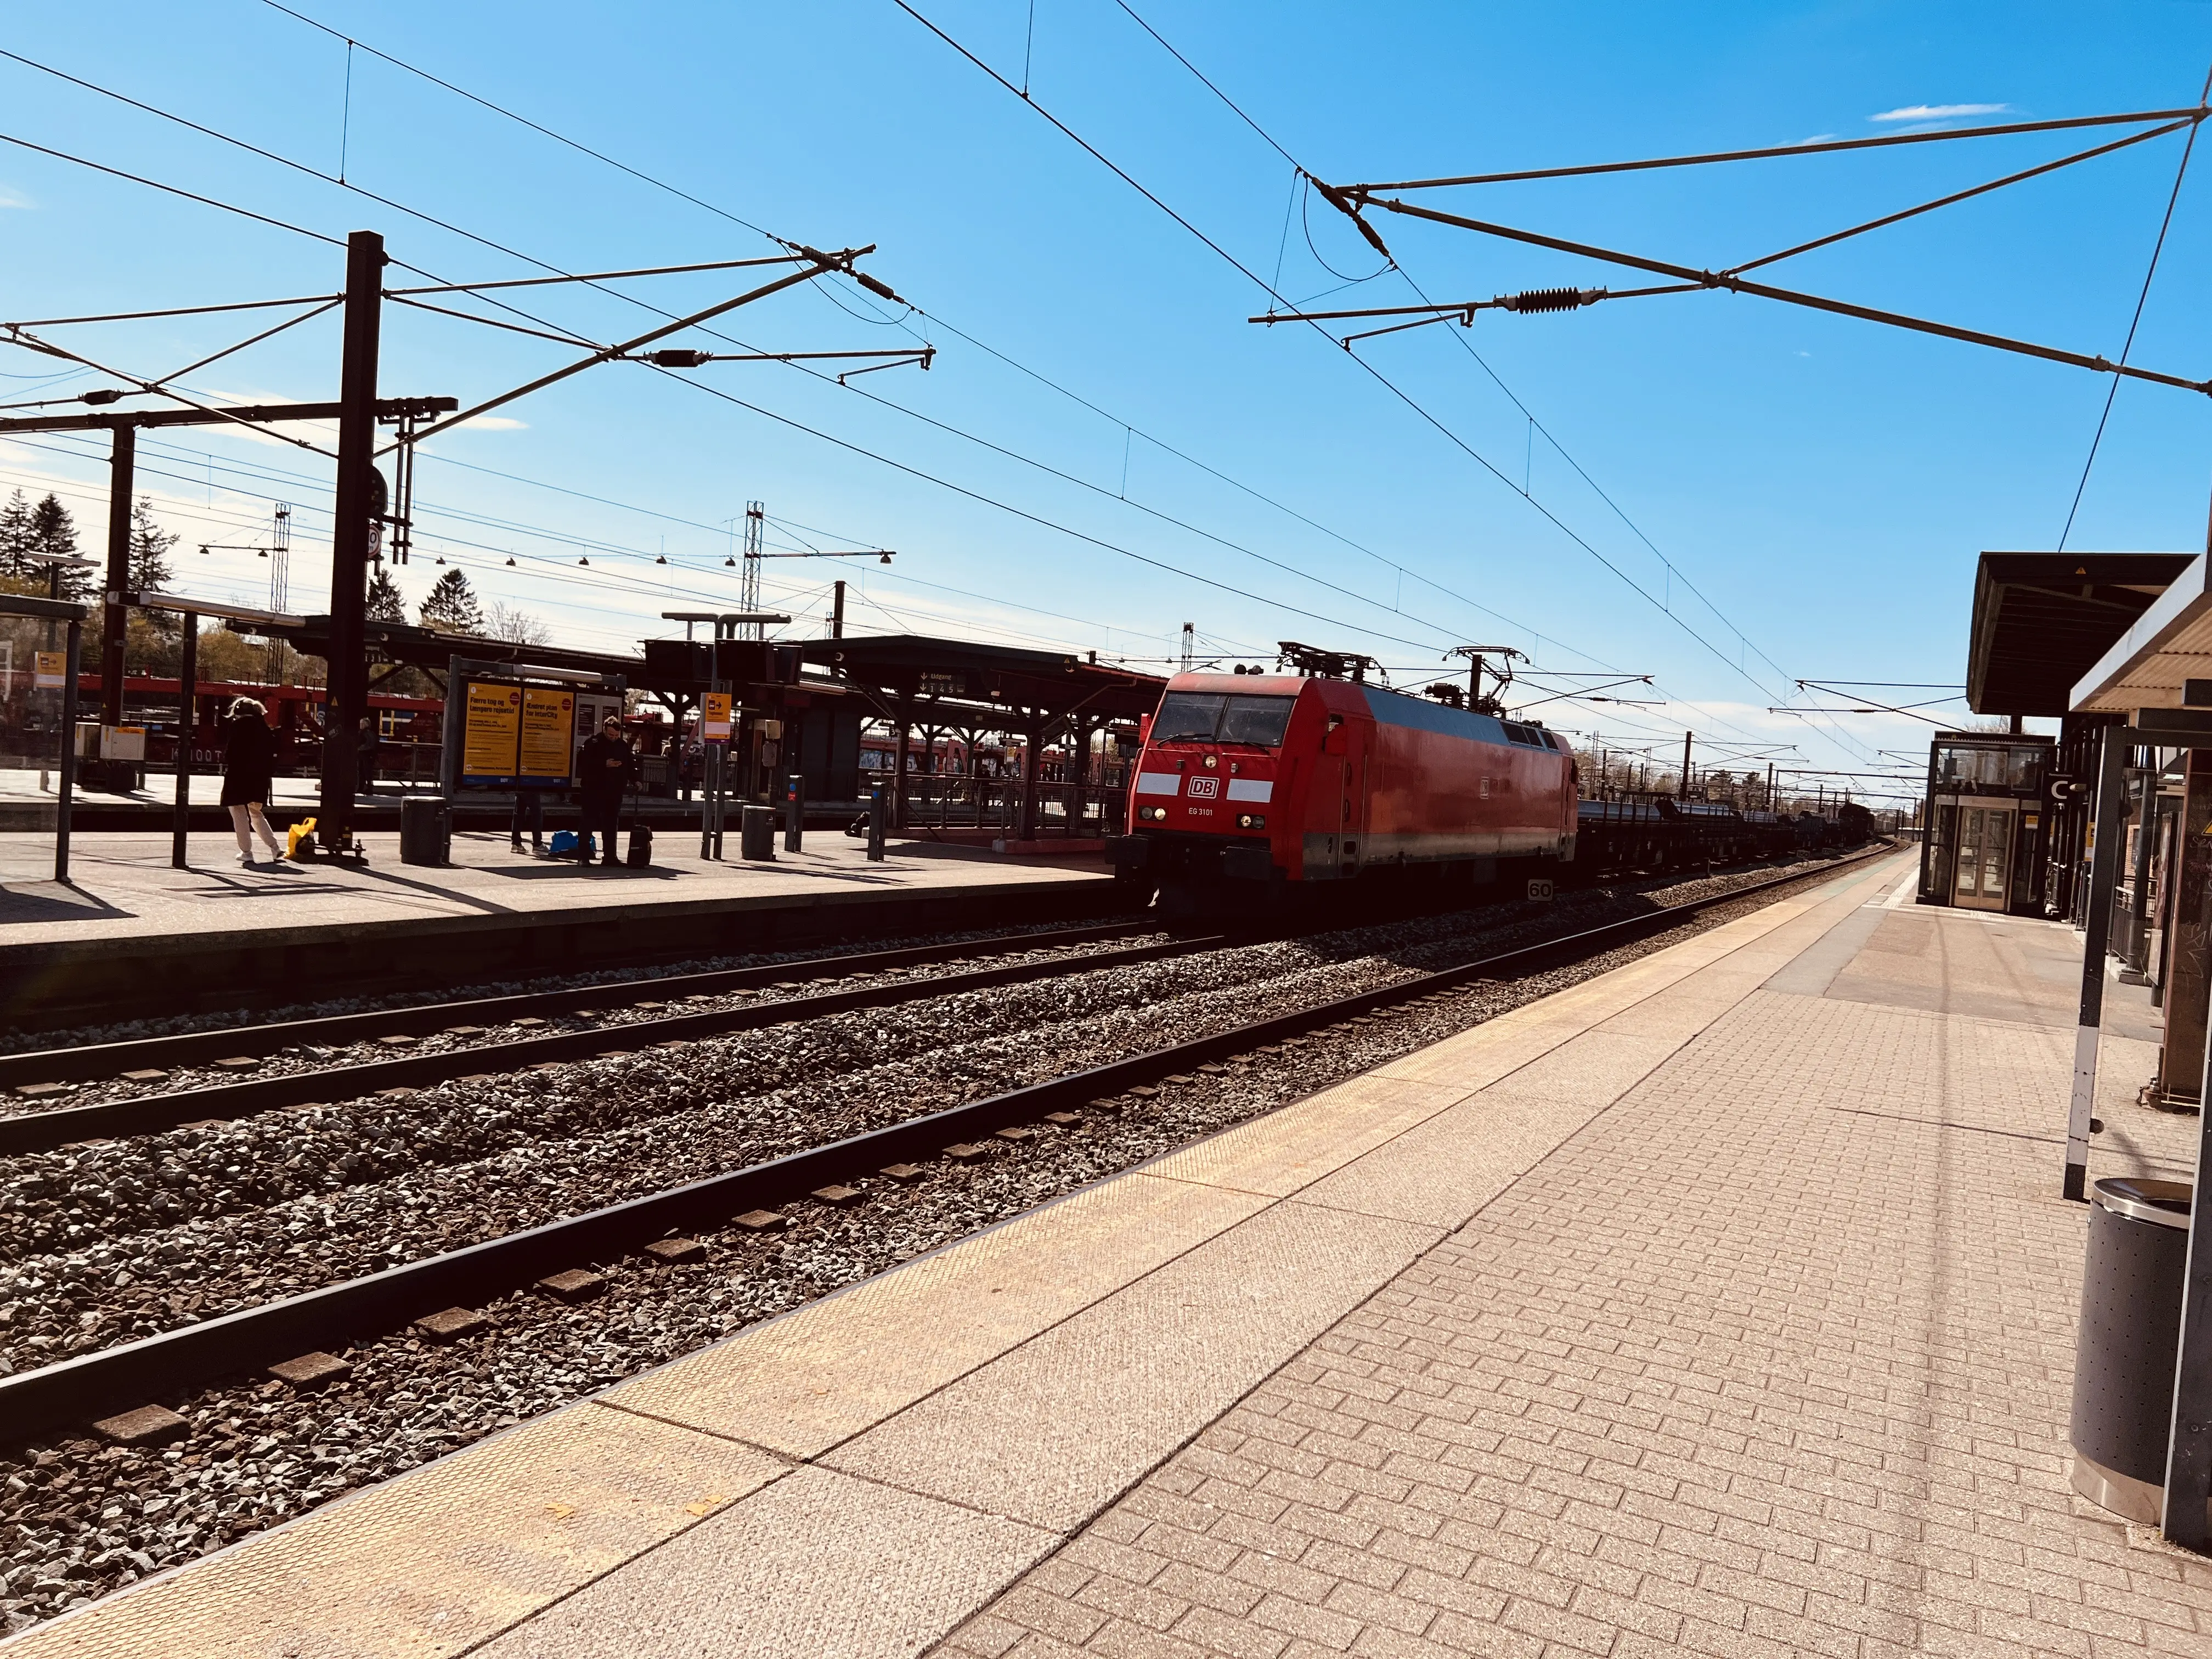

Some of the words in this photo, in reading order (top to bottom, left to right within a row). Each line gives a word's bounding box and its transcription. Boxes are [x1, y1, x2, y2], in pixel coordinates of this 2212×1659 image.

[1193, 781, 1213, 794] DB
[2051, 780, 2068, 799] C
[1199, 808, 1212, 816] 3101
[1529, 883, 1552, 898] 60
